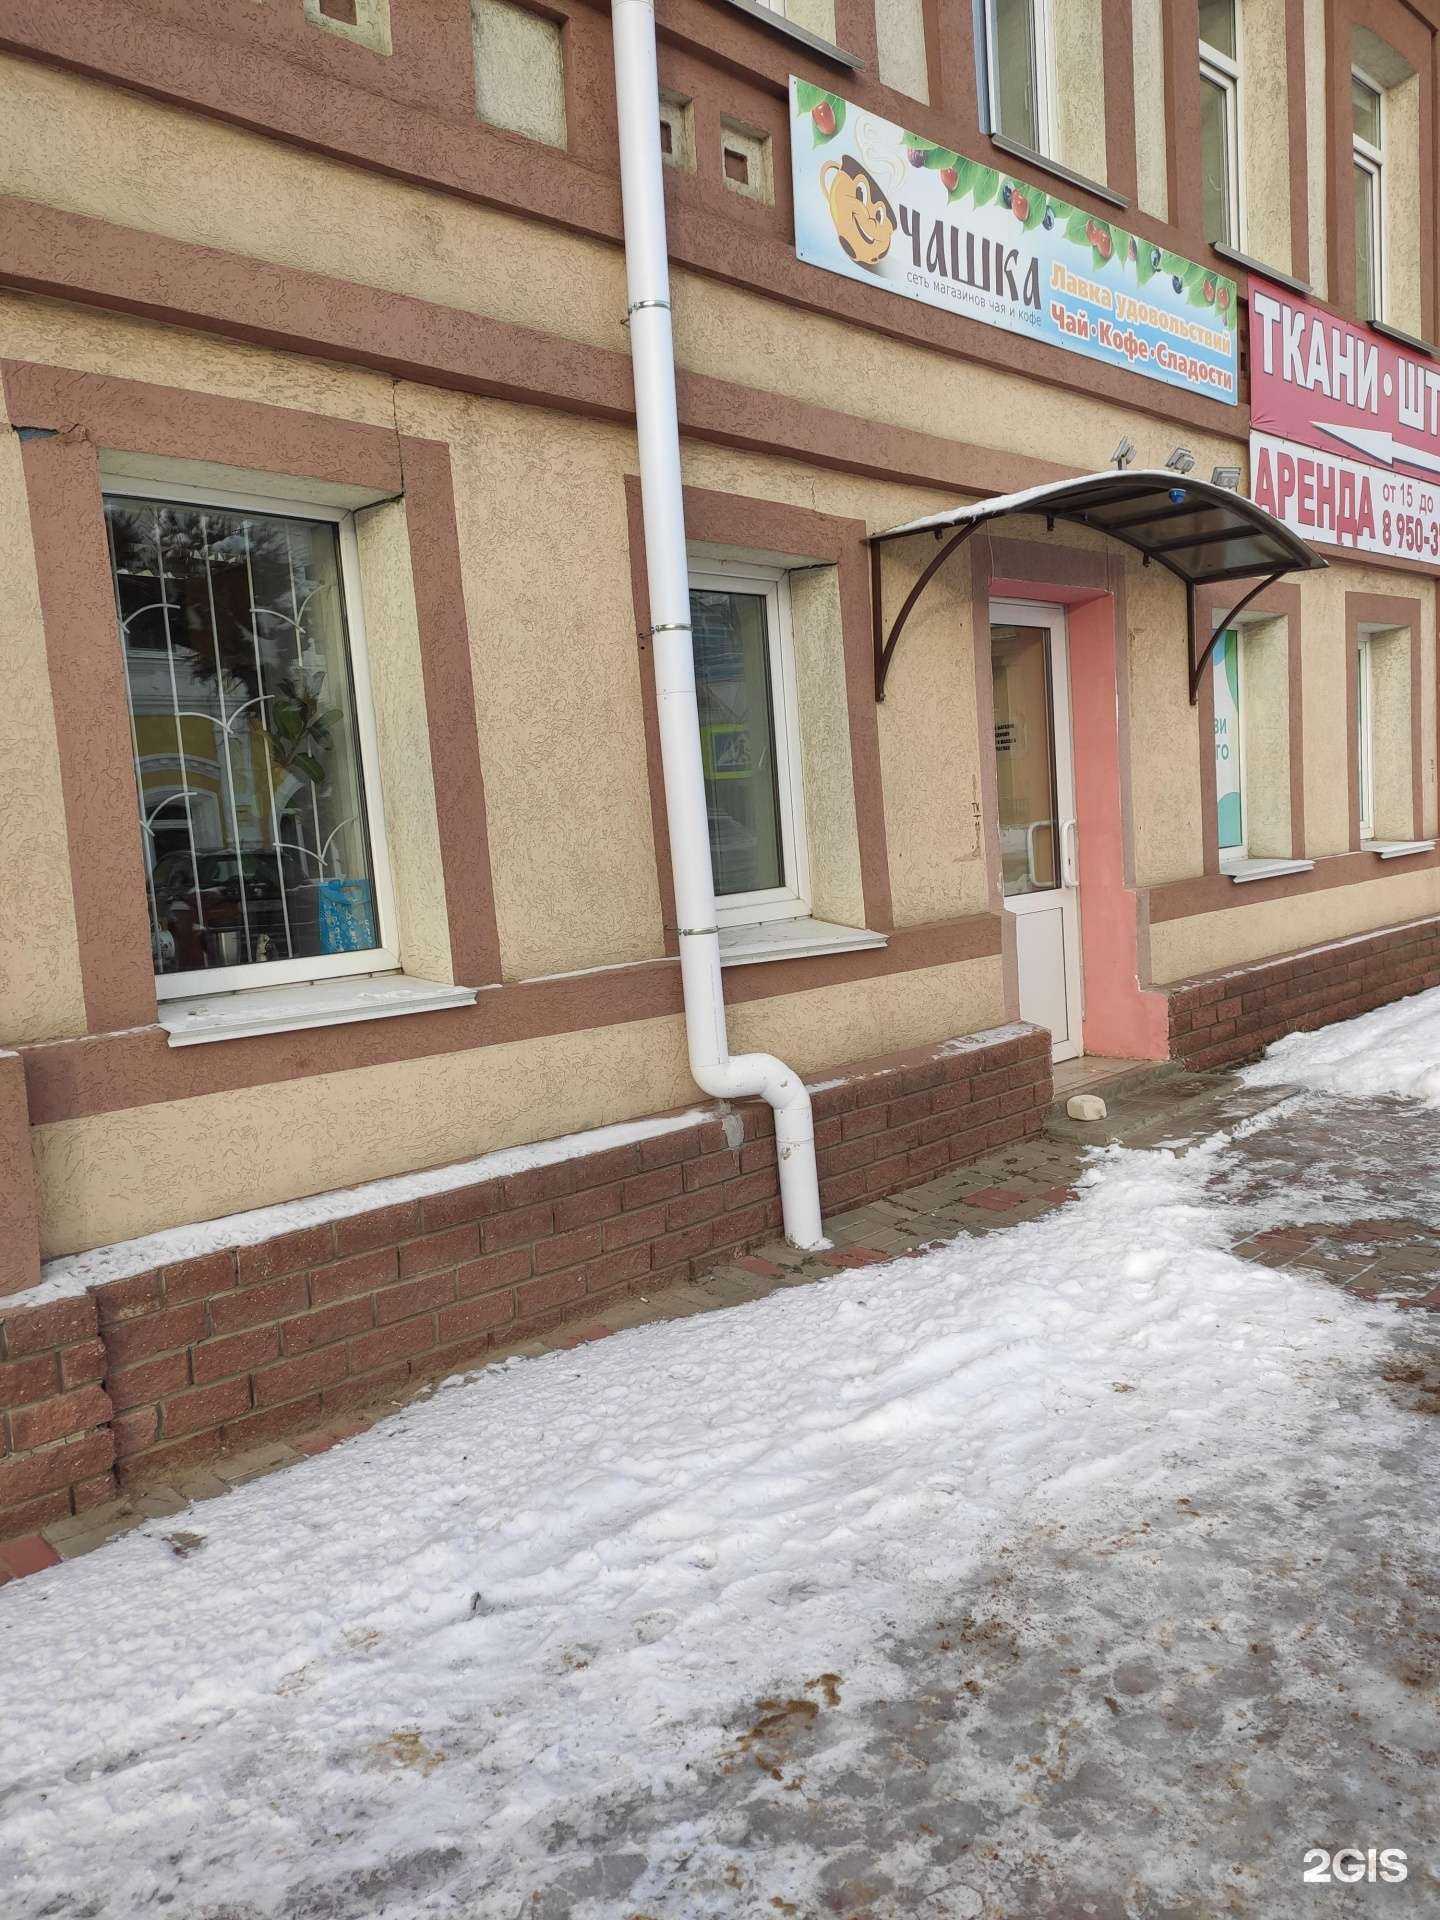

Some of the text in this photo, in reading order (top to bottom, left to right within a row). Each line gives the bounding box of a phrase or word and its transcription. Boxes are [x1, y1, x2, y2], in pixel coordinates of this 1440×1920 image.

[906, 271, 1042, 328] сеть магазинов чая и кофе
[1050, 261, 1231, 357] Лавка удовольствий
[1051, 301, 1233, 391] Чай Кофе Сладости
[1254, 290, 1378, 415] ТКАНИ
[1254, 446, 1376, 547] АРЕНДА
[1382, 509, 1440, 557] 8 950-3
[1383, 482, 1433, 515] от 15 до
